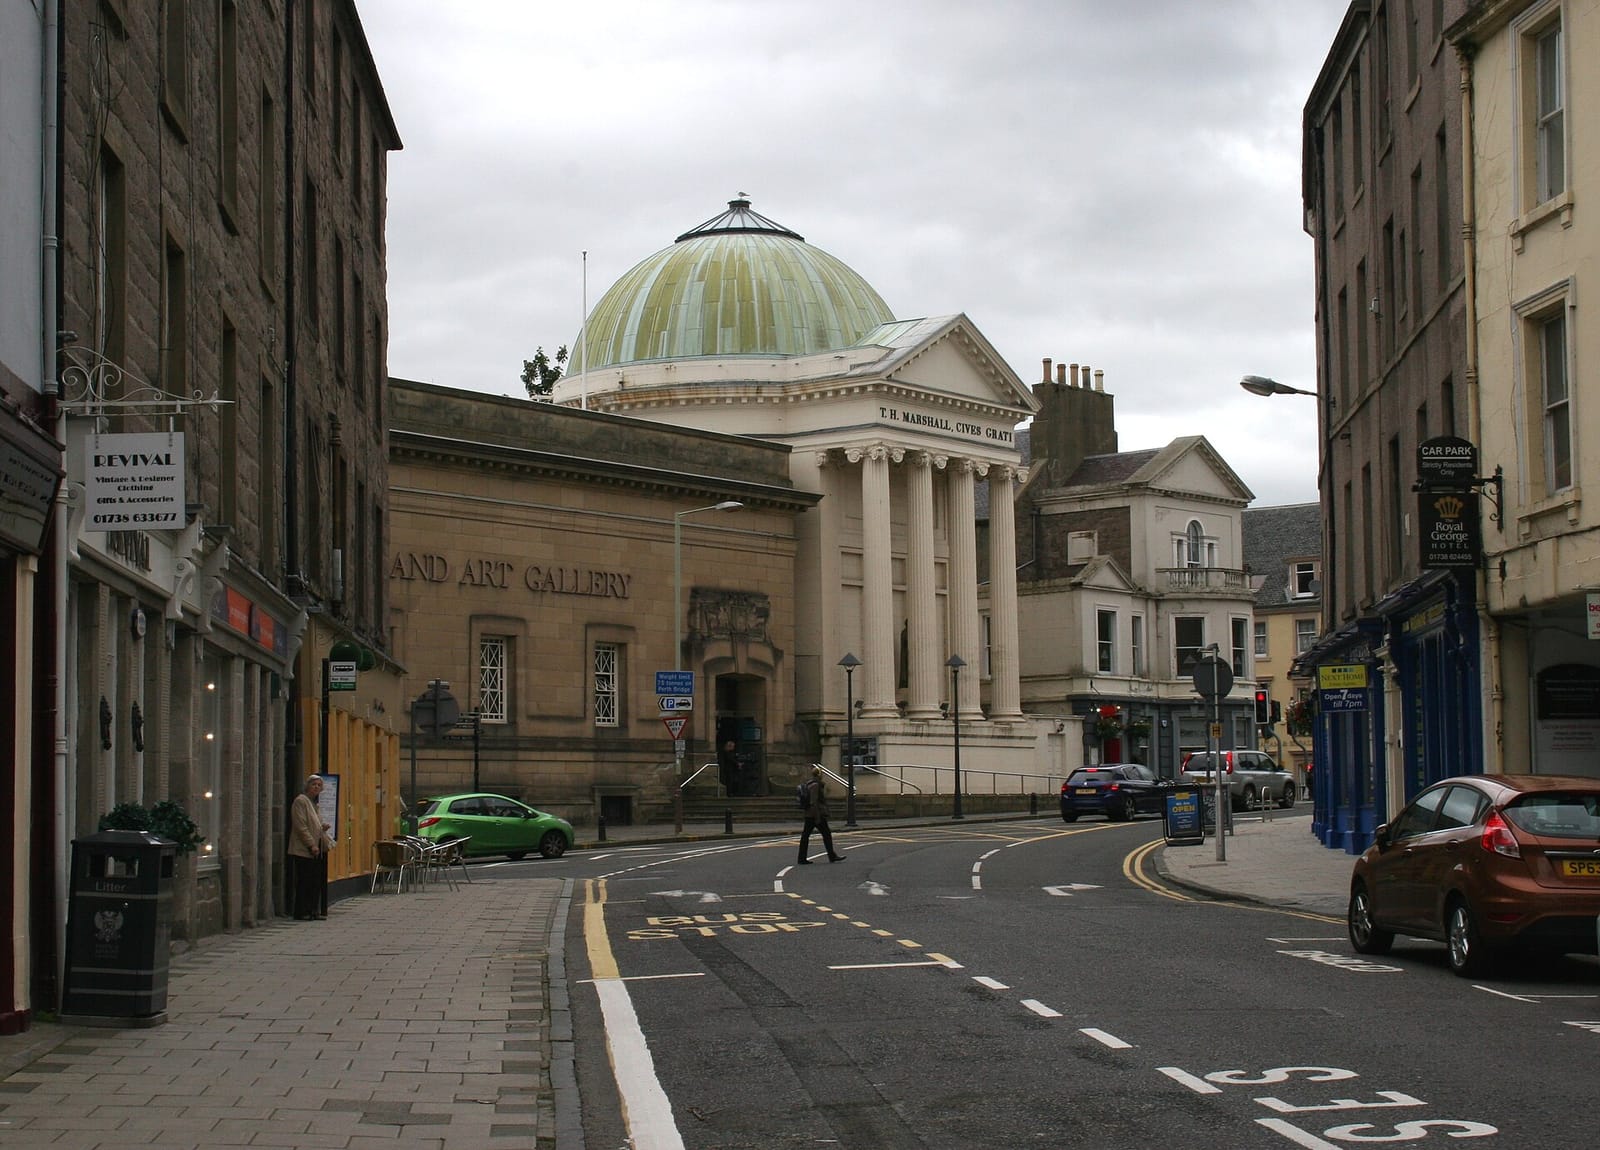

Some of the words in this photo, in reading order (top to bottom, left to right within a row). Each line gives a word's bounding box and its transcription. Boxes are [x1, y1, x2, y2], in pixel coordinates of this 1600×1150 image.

[889, 409, 900, 421] H.
[902, 411, 954, 433] MARSHALL,
[955, 421, 982, 436] CIVES
[985, 427, 1013, 443] GRATI
[1421, 446, 1443, 456] CAR
[1445, 446, 1472, 455] PARK
[93, 453, 177, 468] REVIVAL
[1421, 461, 1442, 470] Strictly
[1443, 461, 1473, 469] Residents
[1440, 469, 1455, 477] Only
[95, 476, 129, 484] Vintage
[138, 475, 176, 484] Designer
[117, 484, 154, 492] Clothing
[96, 496, 117, 505] Gifts
[118, 496, 125, 504] &
[126, 495, 175, 504] Accessories
[93, 514, 130, 524] 01738
[132, 512, 177, 523] 633677
[1435, 521, 1463, 533] Royal
[1431, 531, 1469, 543] George
[390, 551, 449, 583] AND
[459, 558, 514, 589] ART
[524, 565, 632, 600] GALLERY
[1324, 693, 1341, 701] Open
[1340, 689, 1349, 701] 7
[1347, 693, 1363, 701] days
[1345, 700, 1363, 708] 7pm
[1172, 805, 1195, 813] OPEN
[95, 881, 128, 892] Litter
[645, 912, 788, 926] BUS
[625, 921, 828, 941] STOP
